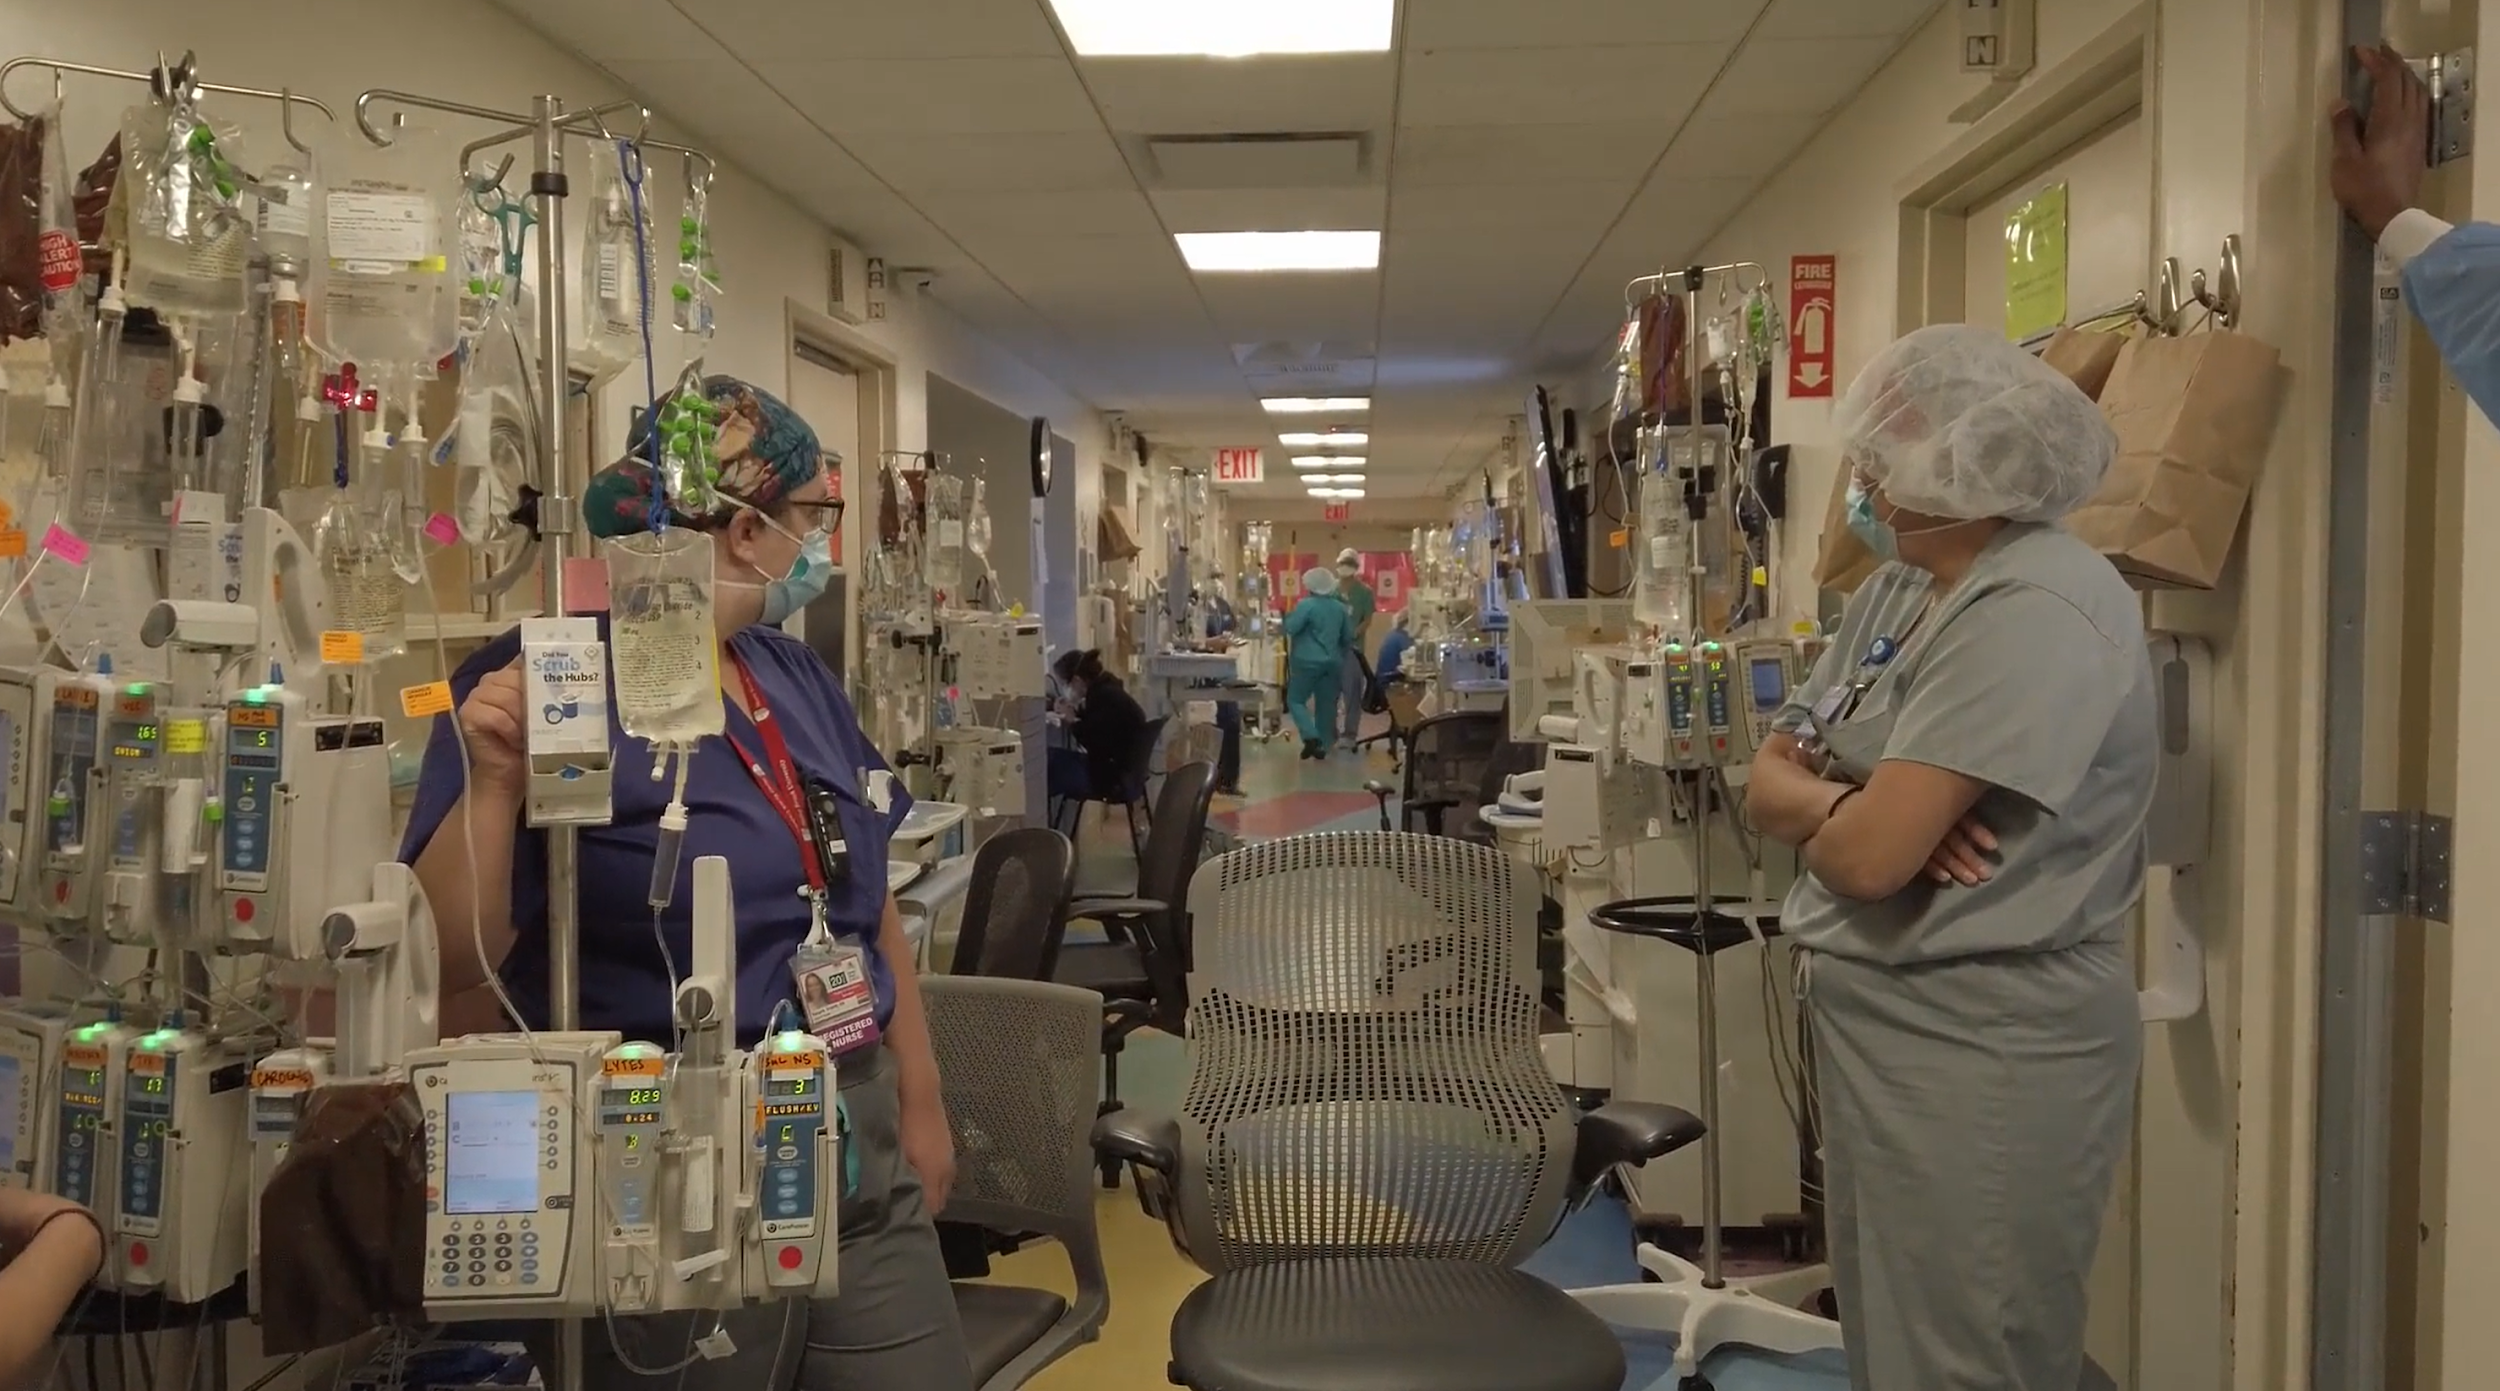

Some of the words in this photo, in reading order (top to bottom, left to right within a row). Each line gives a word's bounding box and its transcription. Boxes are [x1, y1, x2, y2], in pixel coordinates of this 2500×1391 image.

[1795, 263, 1832, 279] FIRE
[1219, 449, 1257, 479] EXIT
[1325, 505, 1349, 520] EXIT
[533, 658, 580, 672] Scrub
[543, 673, 563, 682] the
[565, 672, 599, 682] Hubs?
[257, 731, 267, 746] 5
[831, 1030, 864, 1049] NURSE
[604, 1059, 645, 1072] LYTES
[793, 1053, 811, 1065] NS
[794, 1079, 804, 1094] 3
[629, 1089, 660, 1104] 8.29
[766, 1102, 819, 1114] FLUSH/KV
